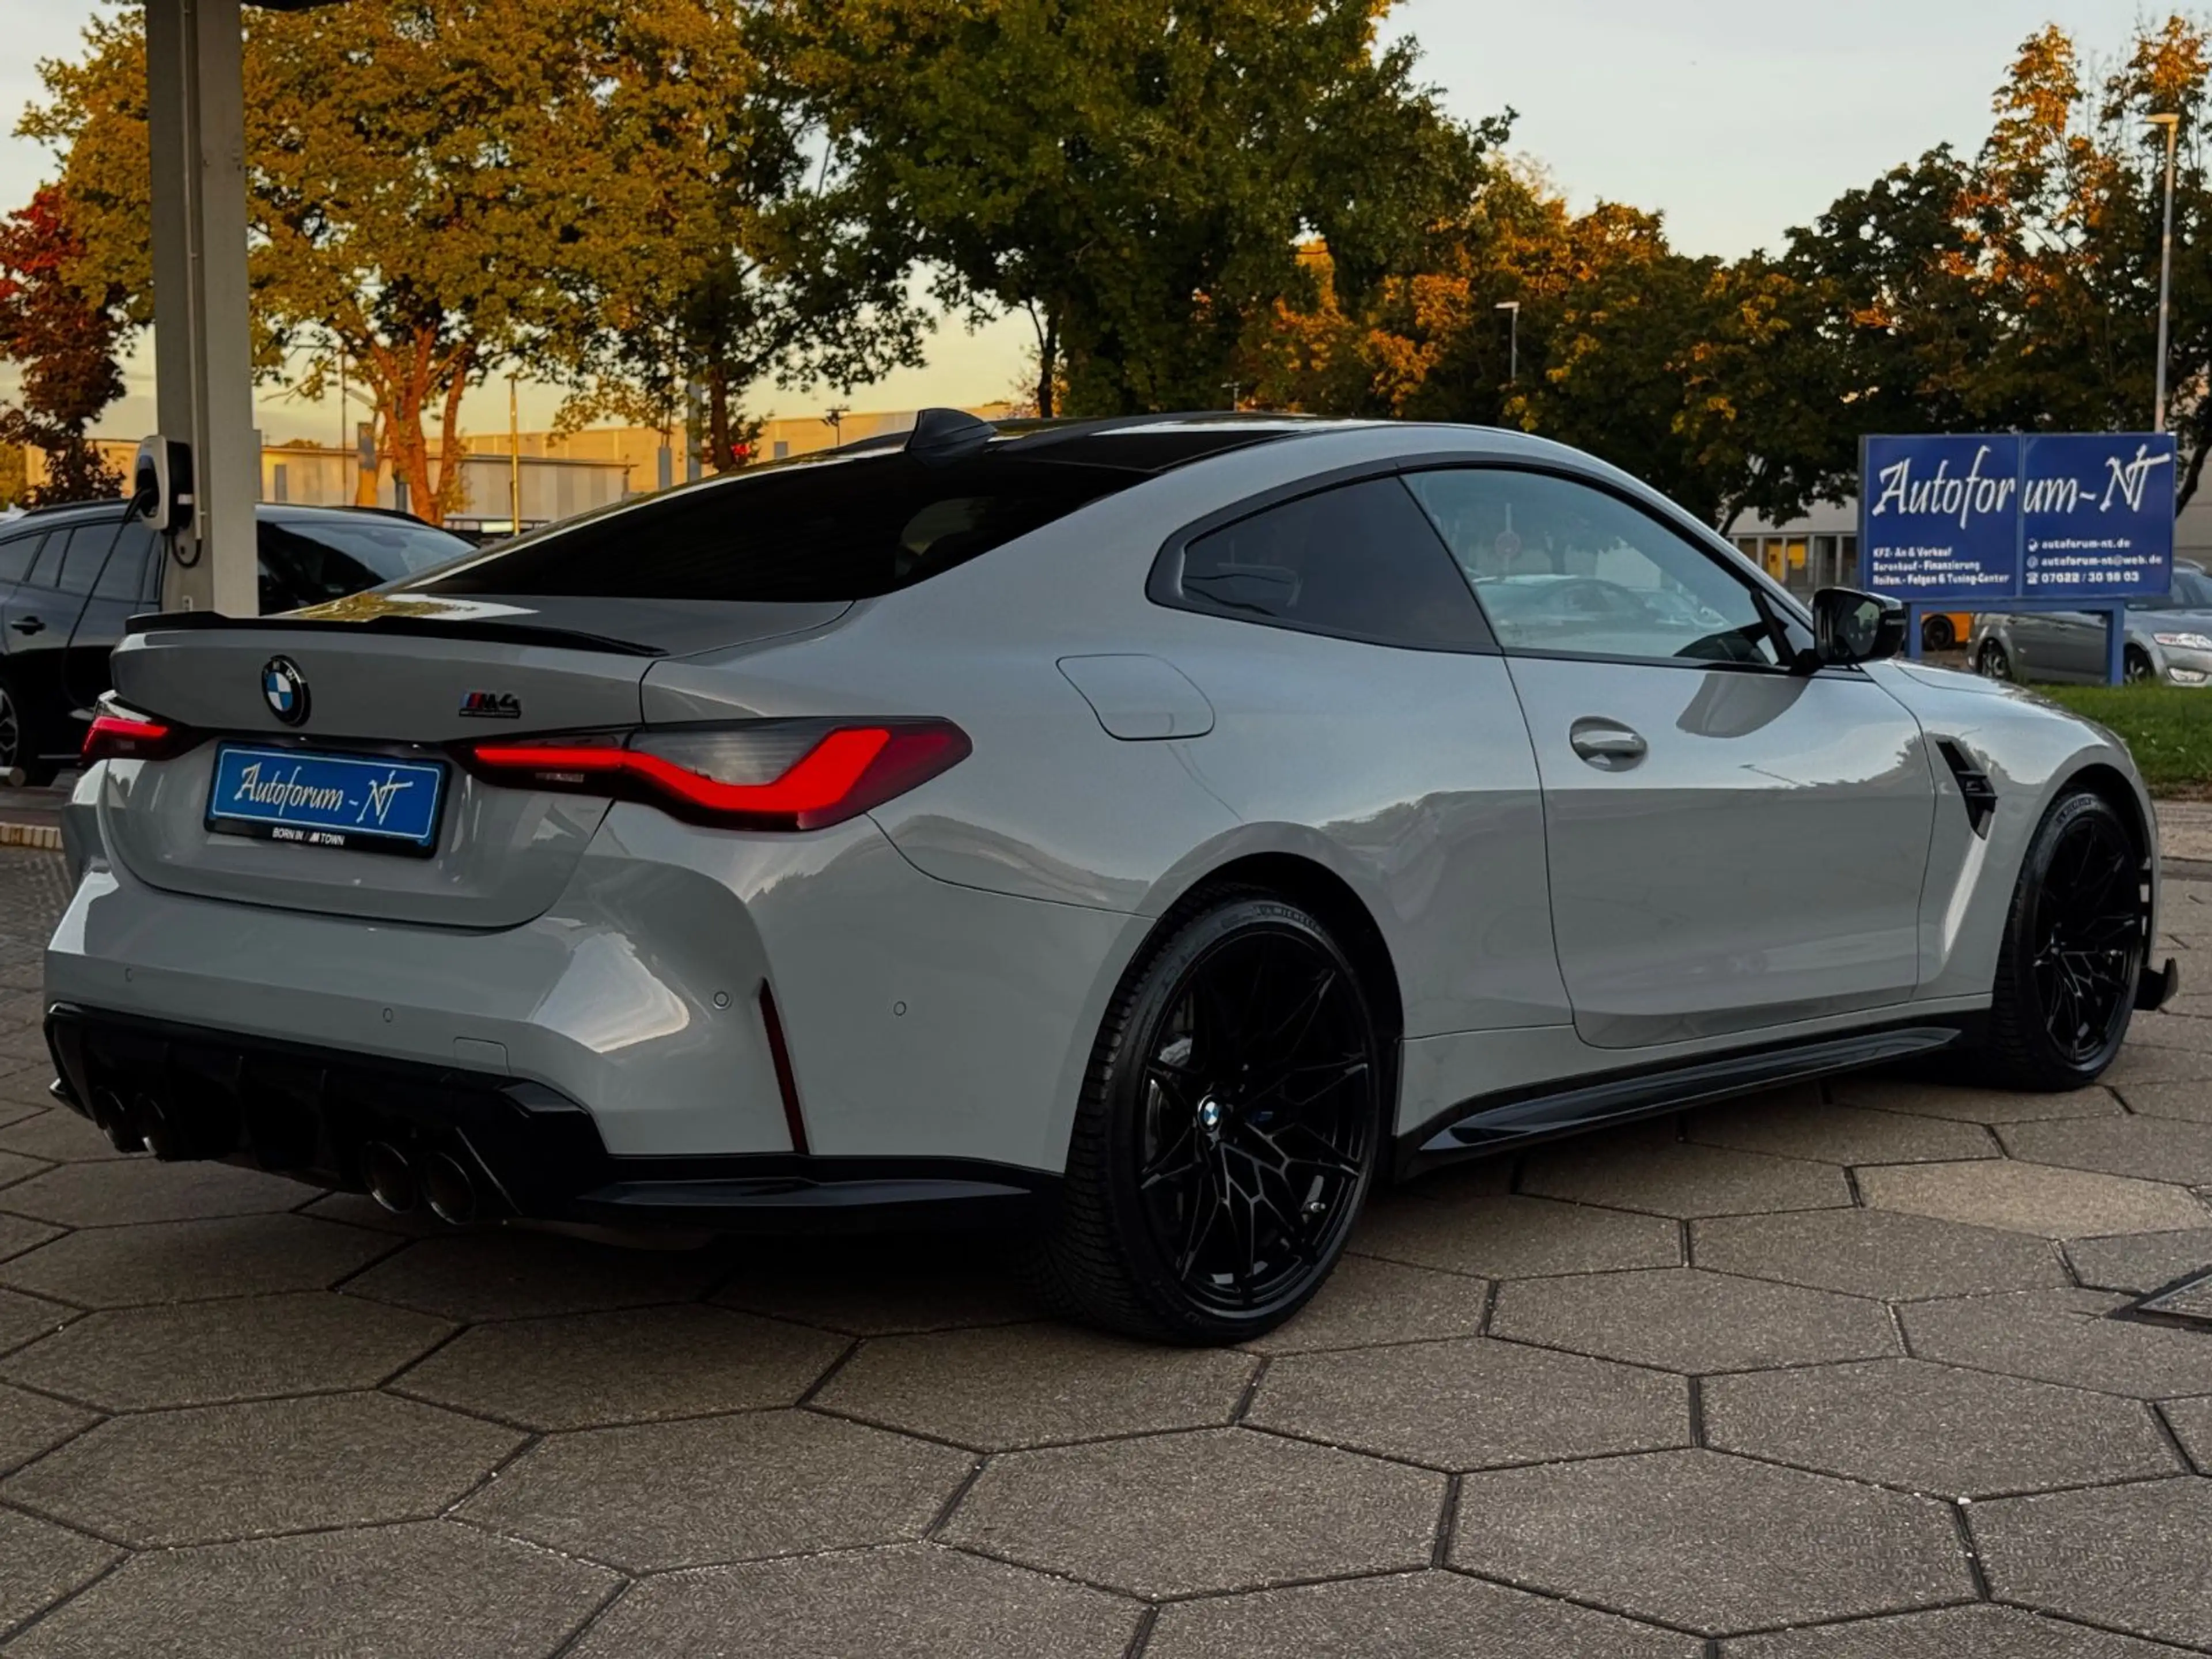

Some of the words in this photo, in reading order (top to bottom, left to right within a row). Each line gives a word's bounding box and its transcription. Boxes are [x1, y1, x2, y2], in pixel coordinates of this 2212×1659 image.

[2041, 539, 2131, 549] autoforum-nt.de
[1895, 547, 1907, 558] An
[1908, 547, 1916, 558] &
[1916, 547, 1953, 558] Verkauf
[1923, 560, 1980, 572] Finanzierung
[2041, 554, 2162, 566] autoforum-nt@web.de
[1907, 574, 1937, 586] Felgen
[1938, 573, 1946, 585] &
[2041, 571, 2080, 584] 07022
[2088, 571, 2104, 583] 30
[272, 827, 295, 840] BORN
[295, 830, 304, 841] IN
[320, 833, 345, 846] TOWN
